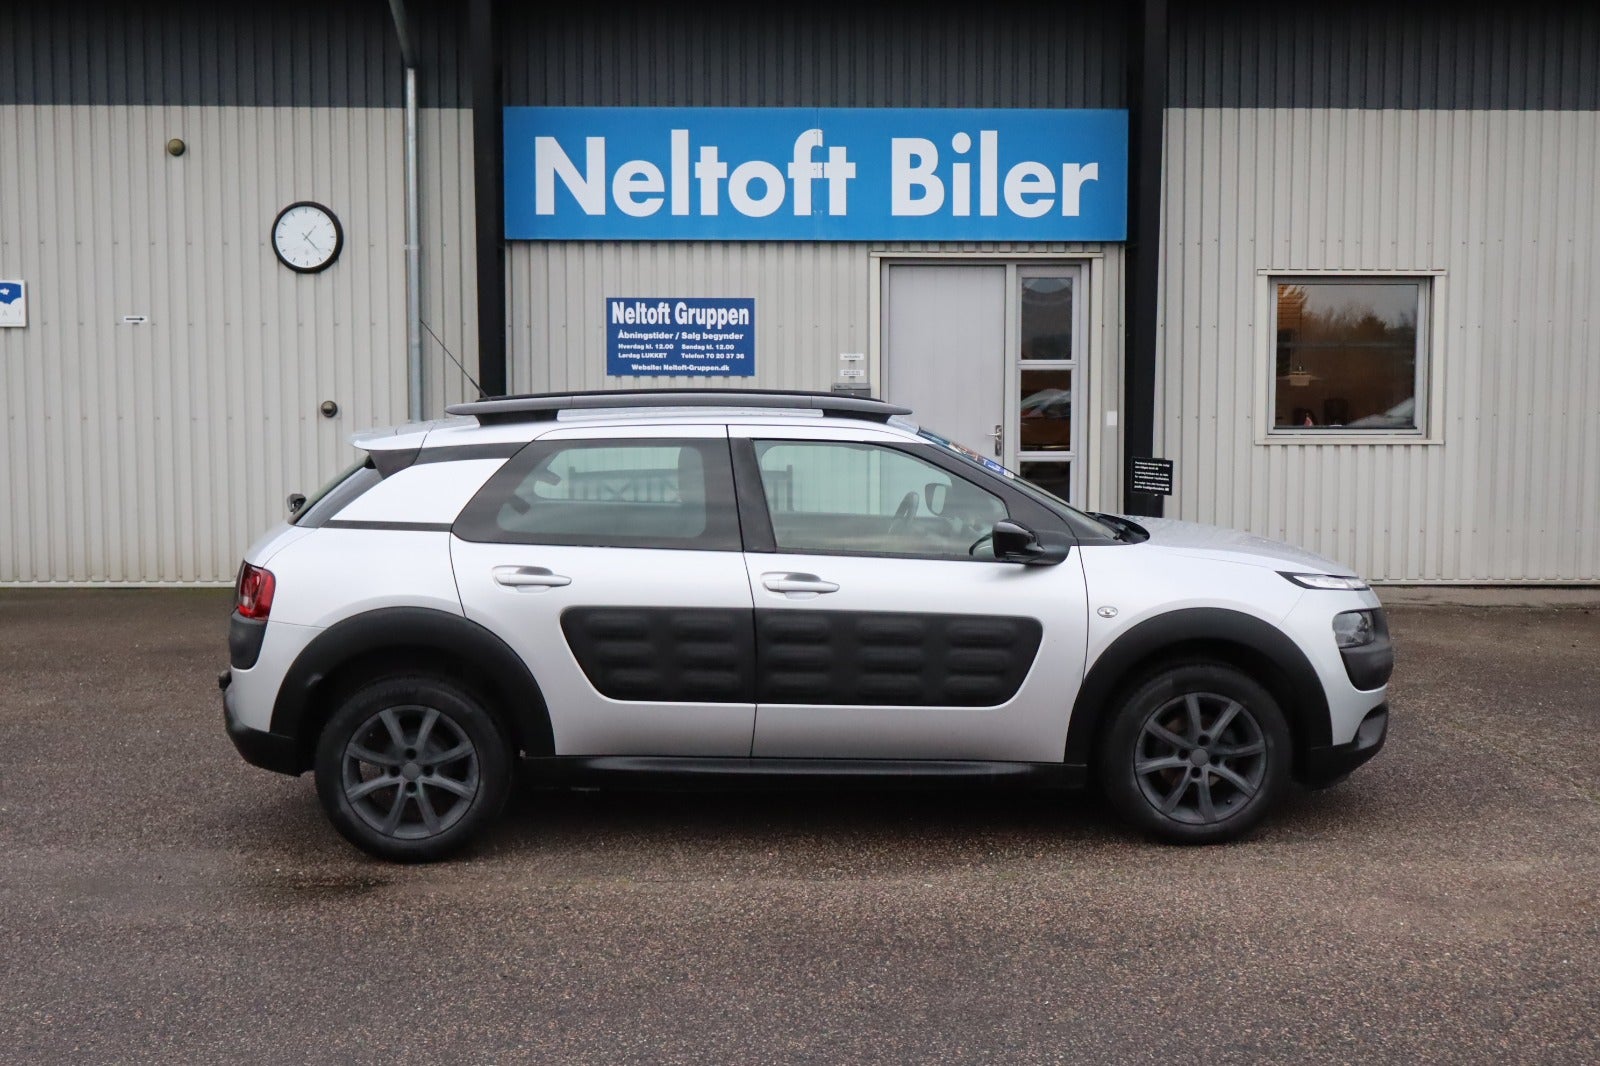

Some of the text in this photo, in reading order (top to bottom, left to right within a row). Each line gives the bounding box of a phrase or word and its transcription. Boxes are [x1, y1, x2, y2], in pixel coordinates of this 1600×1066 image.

[536, 129, 1098, 217] Neltoft Biler
[612, 301, 749, 329] Neltoft Gruppen
[618, 329, 744, 341] Åbningstider / Salg begynder
[663, 364, 730, 372] Neltoft-Gruppen.dk
